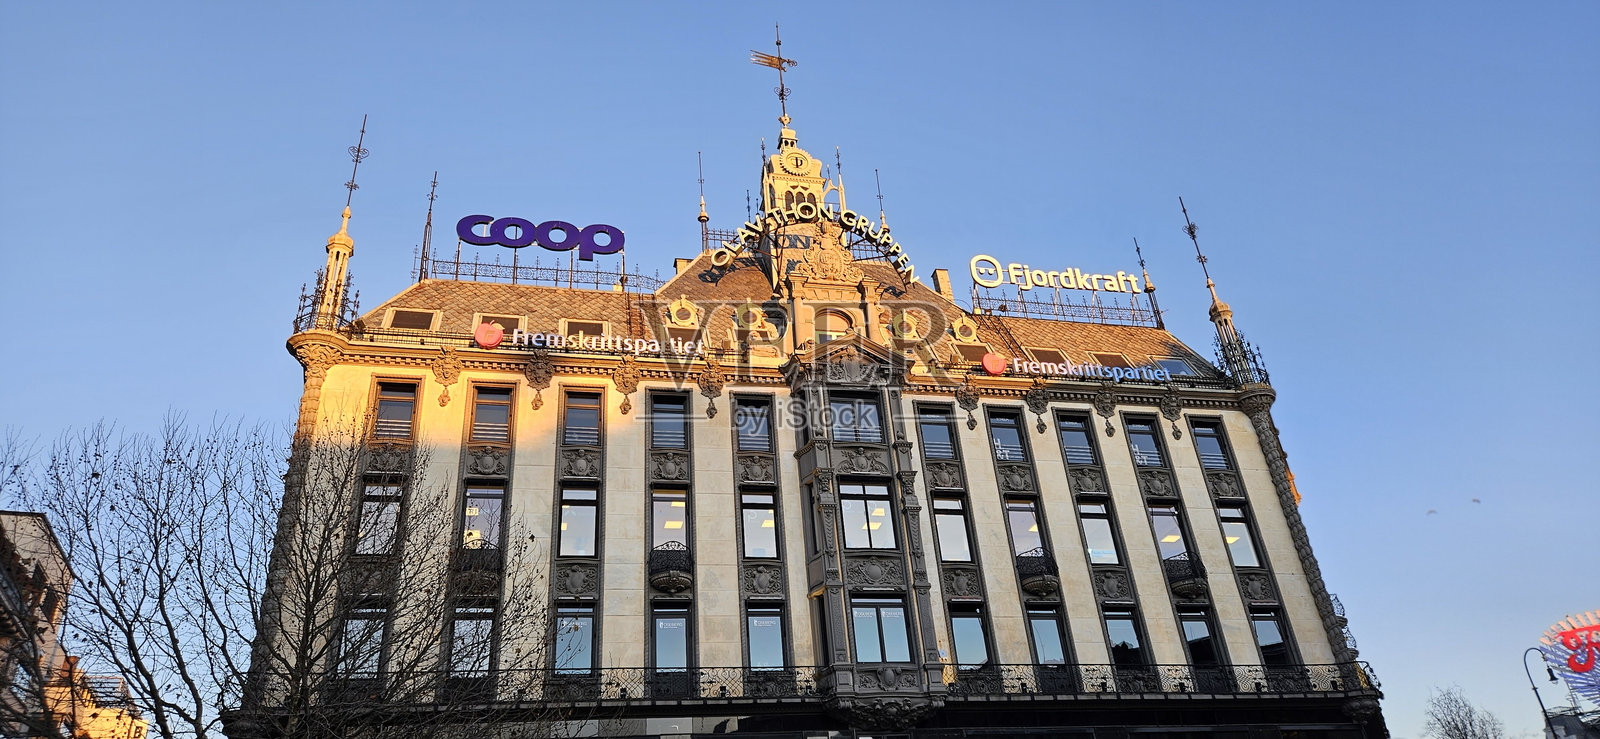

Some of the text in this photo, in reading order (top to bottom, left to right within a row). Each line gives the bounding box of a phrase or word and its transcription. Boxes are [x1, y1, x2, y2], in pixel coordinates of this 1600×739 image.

[456, 214, 625, 261] coop
[711, 202, 920, 284] OLAV THON GRUPPEN
[1008, 263, 1142, 294] Fjordkraft
[512, 328, 705, 355] Fremskrittspartiet
[1013, 357, 1173, 382] Fremskrittspartiet
